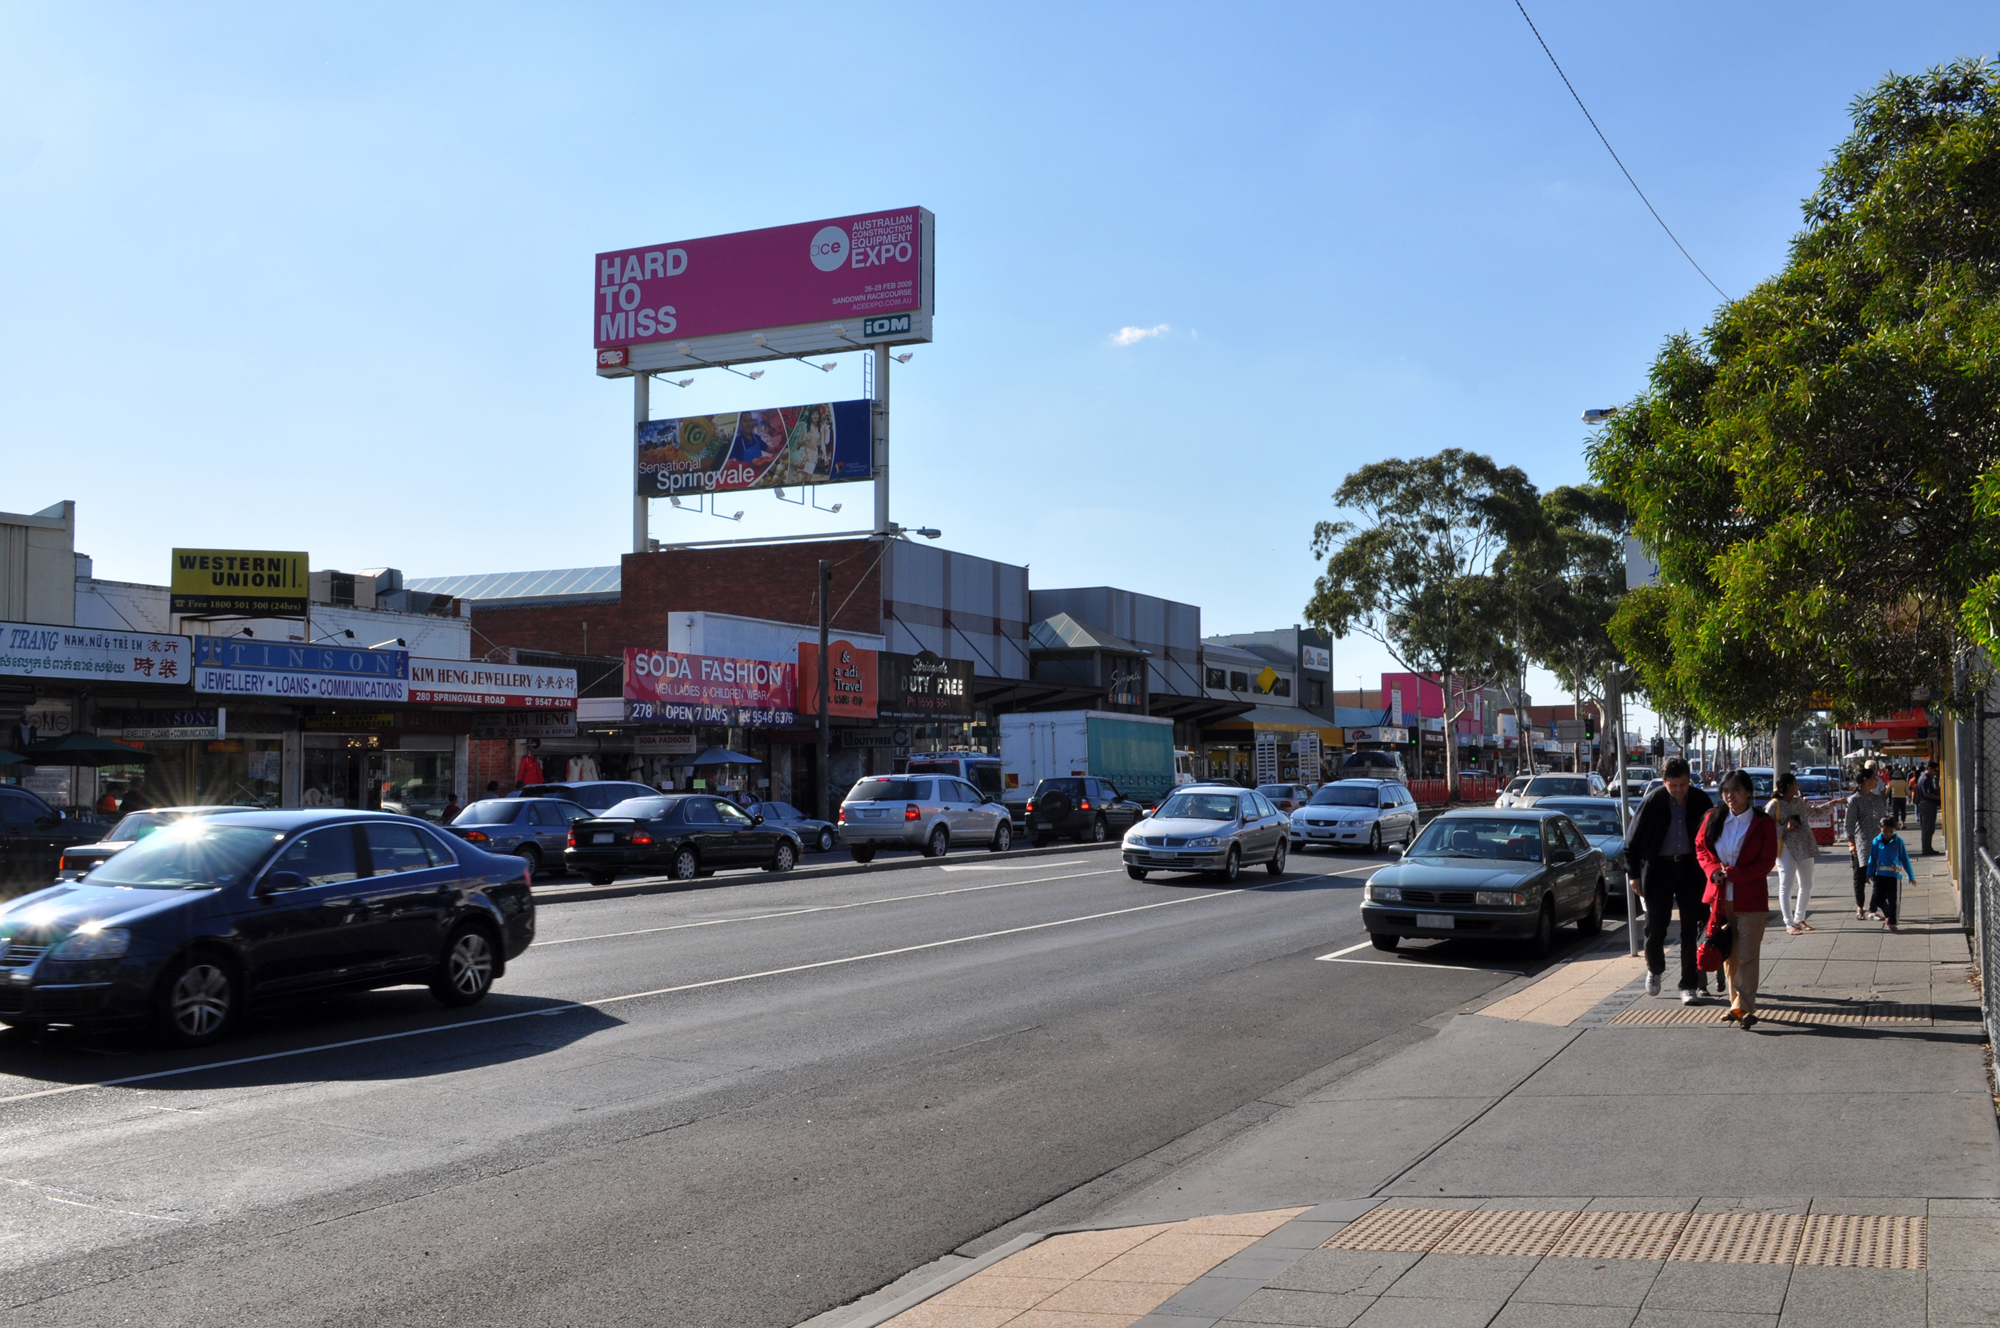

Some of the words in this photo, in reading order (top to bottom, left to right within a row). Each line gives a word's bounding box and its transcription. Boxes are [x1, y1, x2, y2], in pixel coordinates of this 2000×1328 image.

[852, 214, 913, 231] AUSTRALIAN
[852, 223, 913, 239] CONSTRUCTION
[810, 239, 841, 256] ace
[852, 231, 912, 249] EQUIPMENT
[852, 242, 912, 269] EXPO
[600, 248, 688, 286] HARD
[864, 283, 882, 293] 26-28
[883, 282, 896, 291] FEB
[898, 280, 913, 290] 2009
[600, 283, 641, 313] TO
[832, 293, 868, 305] SANDOWN
[869, 288, 912, 300] RACECOURSE
[852, 297, 912, 311] ACEEXPO.COM.AU
[600, 305, 677, 342] MISS
[599, 350, 624, 365] ee
[638, 457, 702, 475] Sensational
[656, 463, 755, 493] Springvale
[179, 555, 281, 572] WESTERN
[212, 572, 281, 588] UNION
[188, 599, 208, 609] Free
[210, 600, 232, 609] 1800
[234, 601, 250, 610] 501
[252, 601, 269, 610] 500
[270, 602, 301, 612] (24hrs)
[9, 628, 59, 652] TRANG
[104, 638, 110, 649] &
[131, 639, 143, 651] EM
[230, 644, 390, 674] TINSON
[841, 650, 851, 663] &
[412, 666, 434, 683] KIM
[437, 668, 469, 685] HENG
[471, 670, 533, 688] JEWELLERY
[635, 653, 693, 680] SODA
[700, 658, 782, 686] FASHION
[202, 671, 266, 691] JEWELLERY
[275, 675, 310, 694] LOANS
[319, 678, 403, 699] COMMUNICATIONS
[674, 684, 701, 697] LADIES
[702, 686, 708, 697] &
[746, 689, 767, 700] WEAR
[834, 678, 863, 692] Travel
[901, 675, 930, 693] DUTY
[936, 677, 964, 696] FREE
[416, 692, 431, 702] 280
[433, 693, 482, 705] SPRINGVALE
[484, 695, 506, 705] ROAD
[535, 697, 553, 707] 9547
[554, 698, 572, 708] 4374
[506, 713, 529, 727] KIM
[535, 712, 569, 726] HENG
[633, 703, 653, 718] 278
[666, 705, 693, 720] OPEN
[696, 707, 703, 720] 7
[704, 707, 728, 722] DAYS
[738, 709, 751, 723] Tel:
[752, 710, 773, 724] 9546
[774, 712, 793, 725] 6376
[639, 736, 657, 744] SODA
[659, 736, 691, 744] FASHIONS
[854, 737, 875, 745] DUTY
[875, 737, 892, 745] FREE
